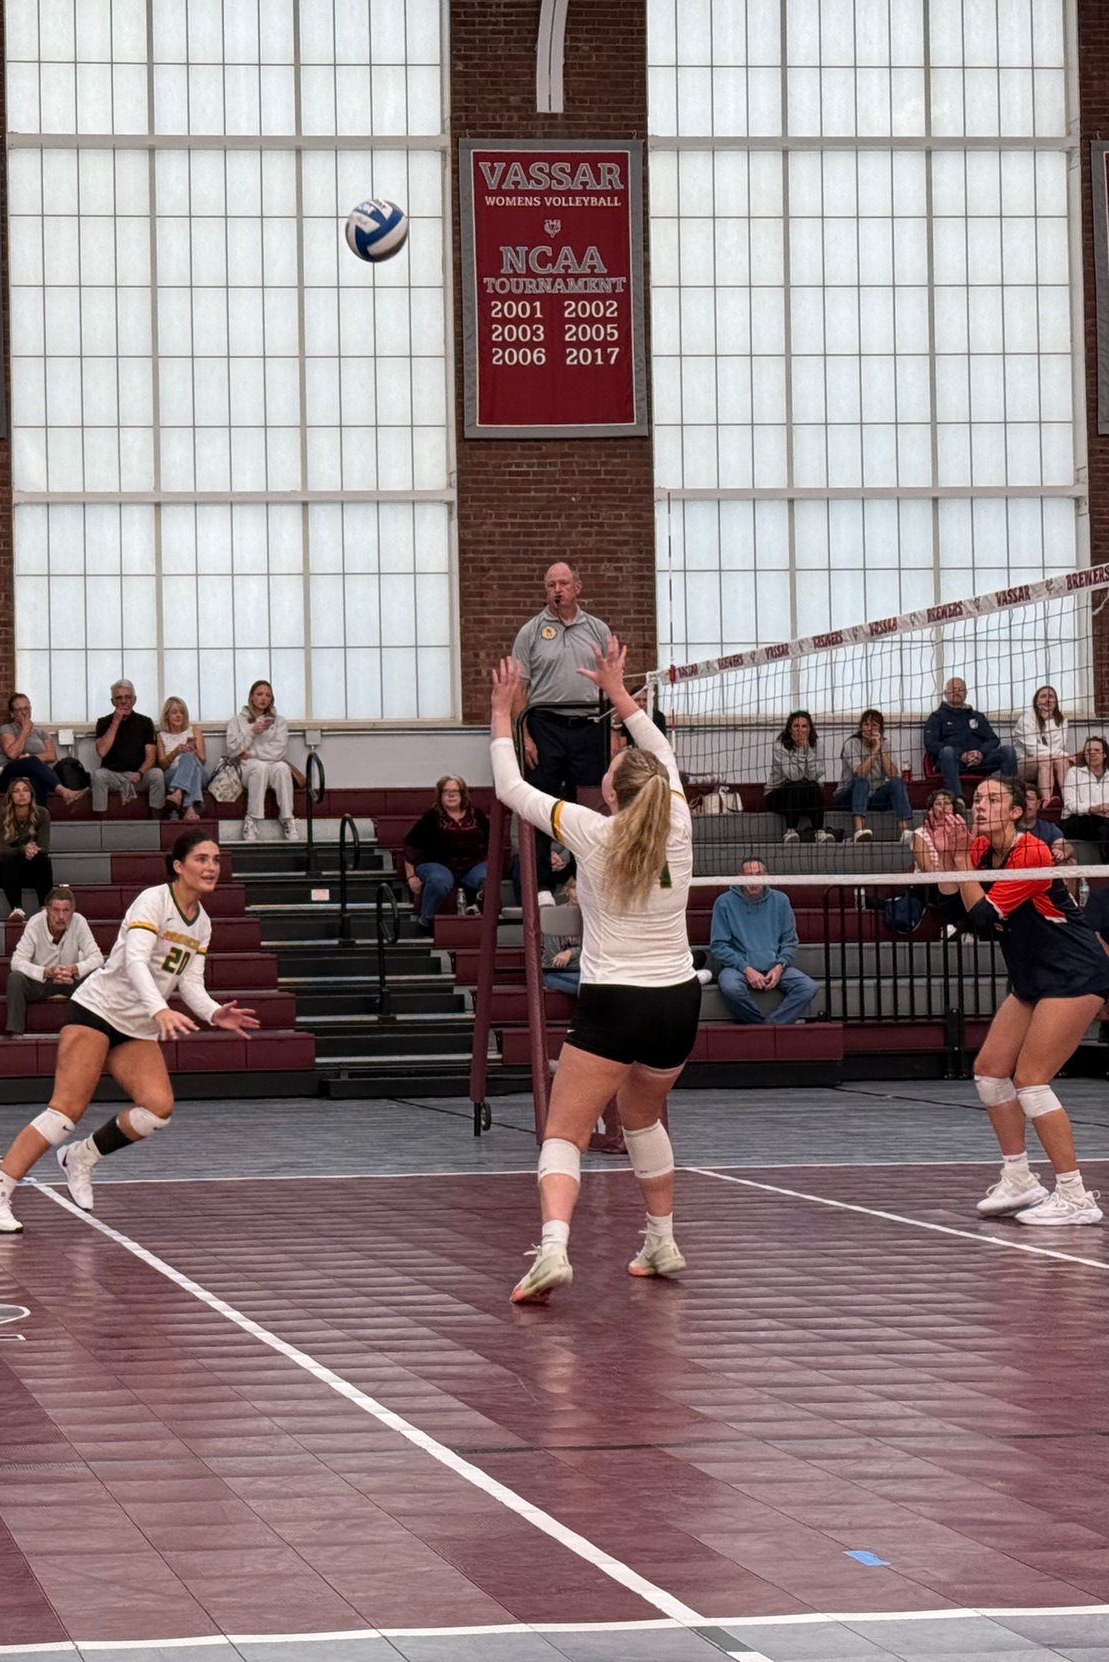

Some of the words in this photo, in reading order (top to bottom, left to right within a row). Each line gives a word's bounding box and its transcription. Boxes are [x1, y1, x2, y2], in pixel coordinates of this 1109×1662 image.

[479, 162, 625, 190] VASSAR
[485, 196, 541, 207] WOMENS
[544, 196, 622, 207] VOLLEYBALL
[500, 246, 607, 274] NCAA
[483, 277, 627, 294] TOURNAMENT
[491, 301, 544, 319] 2001
[563, 301, 618, 319] 2002
[491, 324, 545, 342] 2003
[564, 324, 619, 342] 2005
[492, 348, 547, 366] 2006
[565, 347, 620, 366] 2017
[927, 600, 963, 623] BREWERS
[995, 584, 1031, 608] VASSAR
